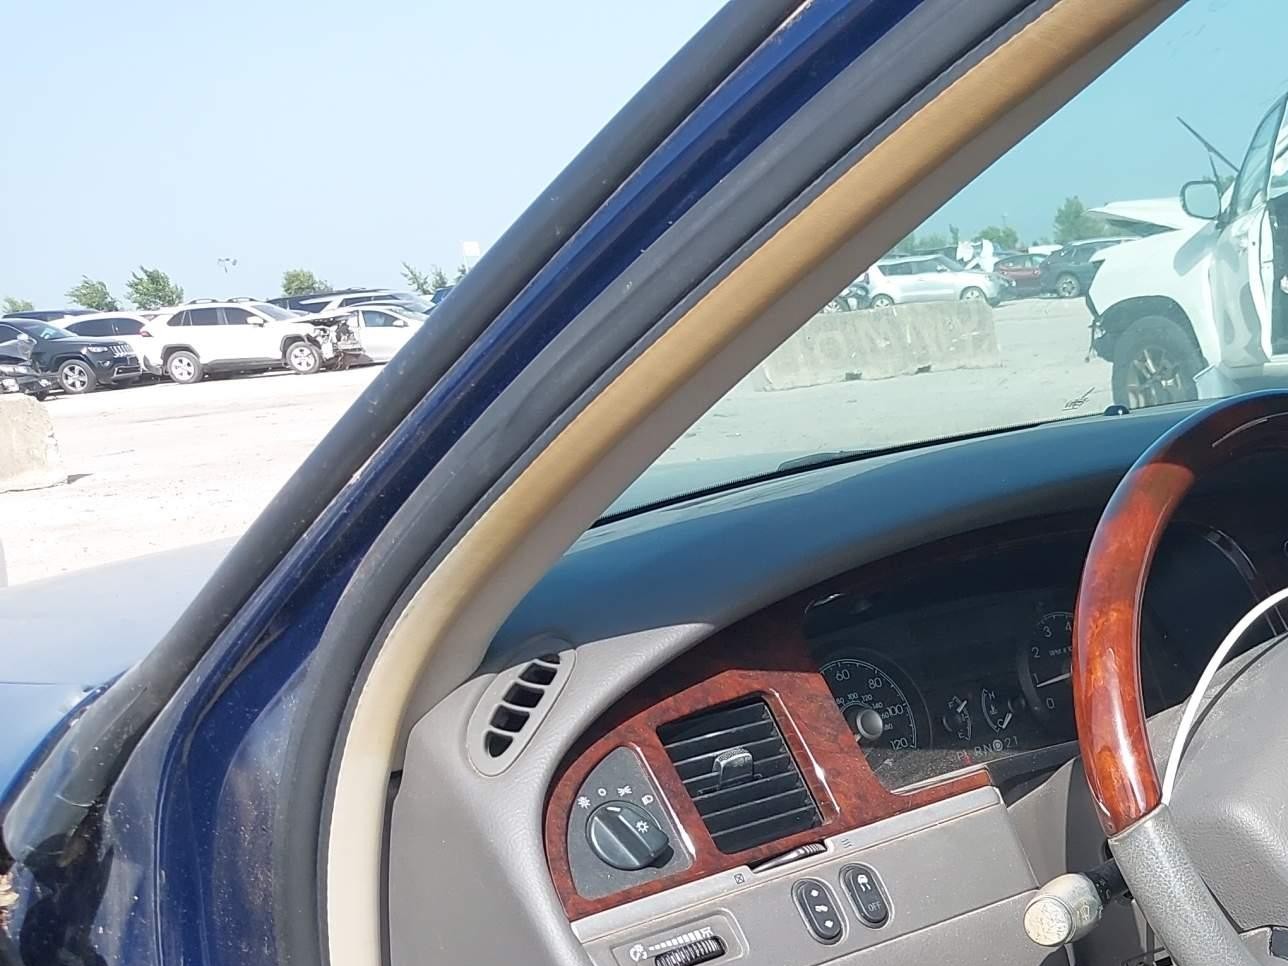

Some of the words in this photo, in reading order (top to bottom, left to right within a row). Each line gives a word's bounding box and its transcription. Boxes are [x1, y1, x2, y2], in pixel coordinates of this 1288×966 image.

[1043, 626, 1052, 638] 3
[1031, 646, 1041, 658] 2
[836, 669, 850, 681] 60
[868, 677, 882, 690] 80
[1046, 698, 1055, 709] 0
[886, 704, 904, 716] 100
[890, 737, 908, 751] 120
[868, 901, 882, 912] OFF
